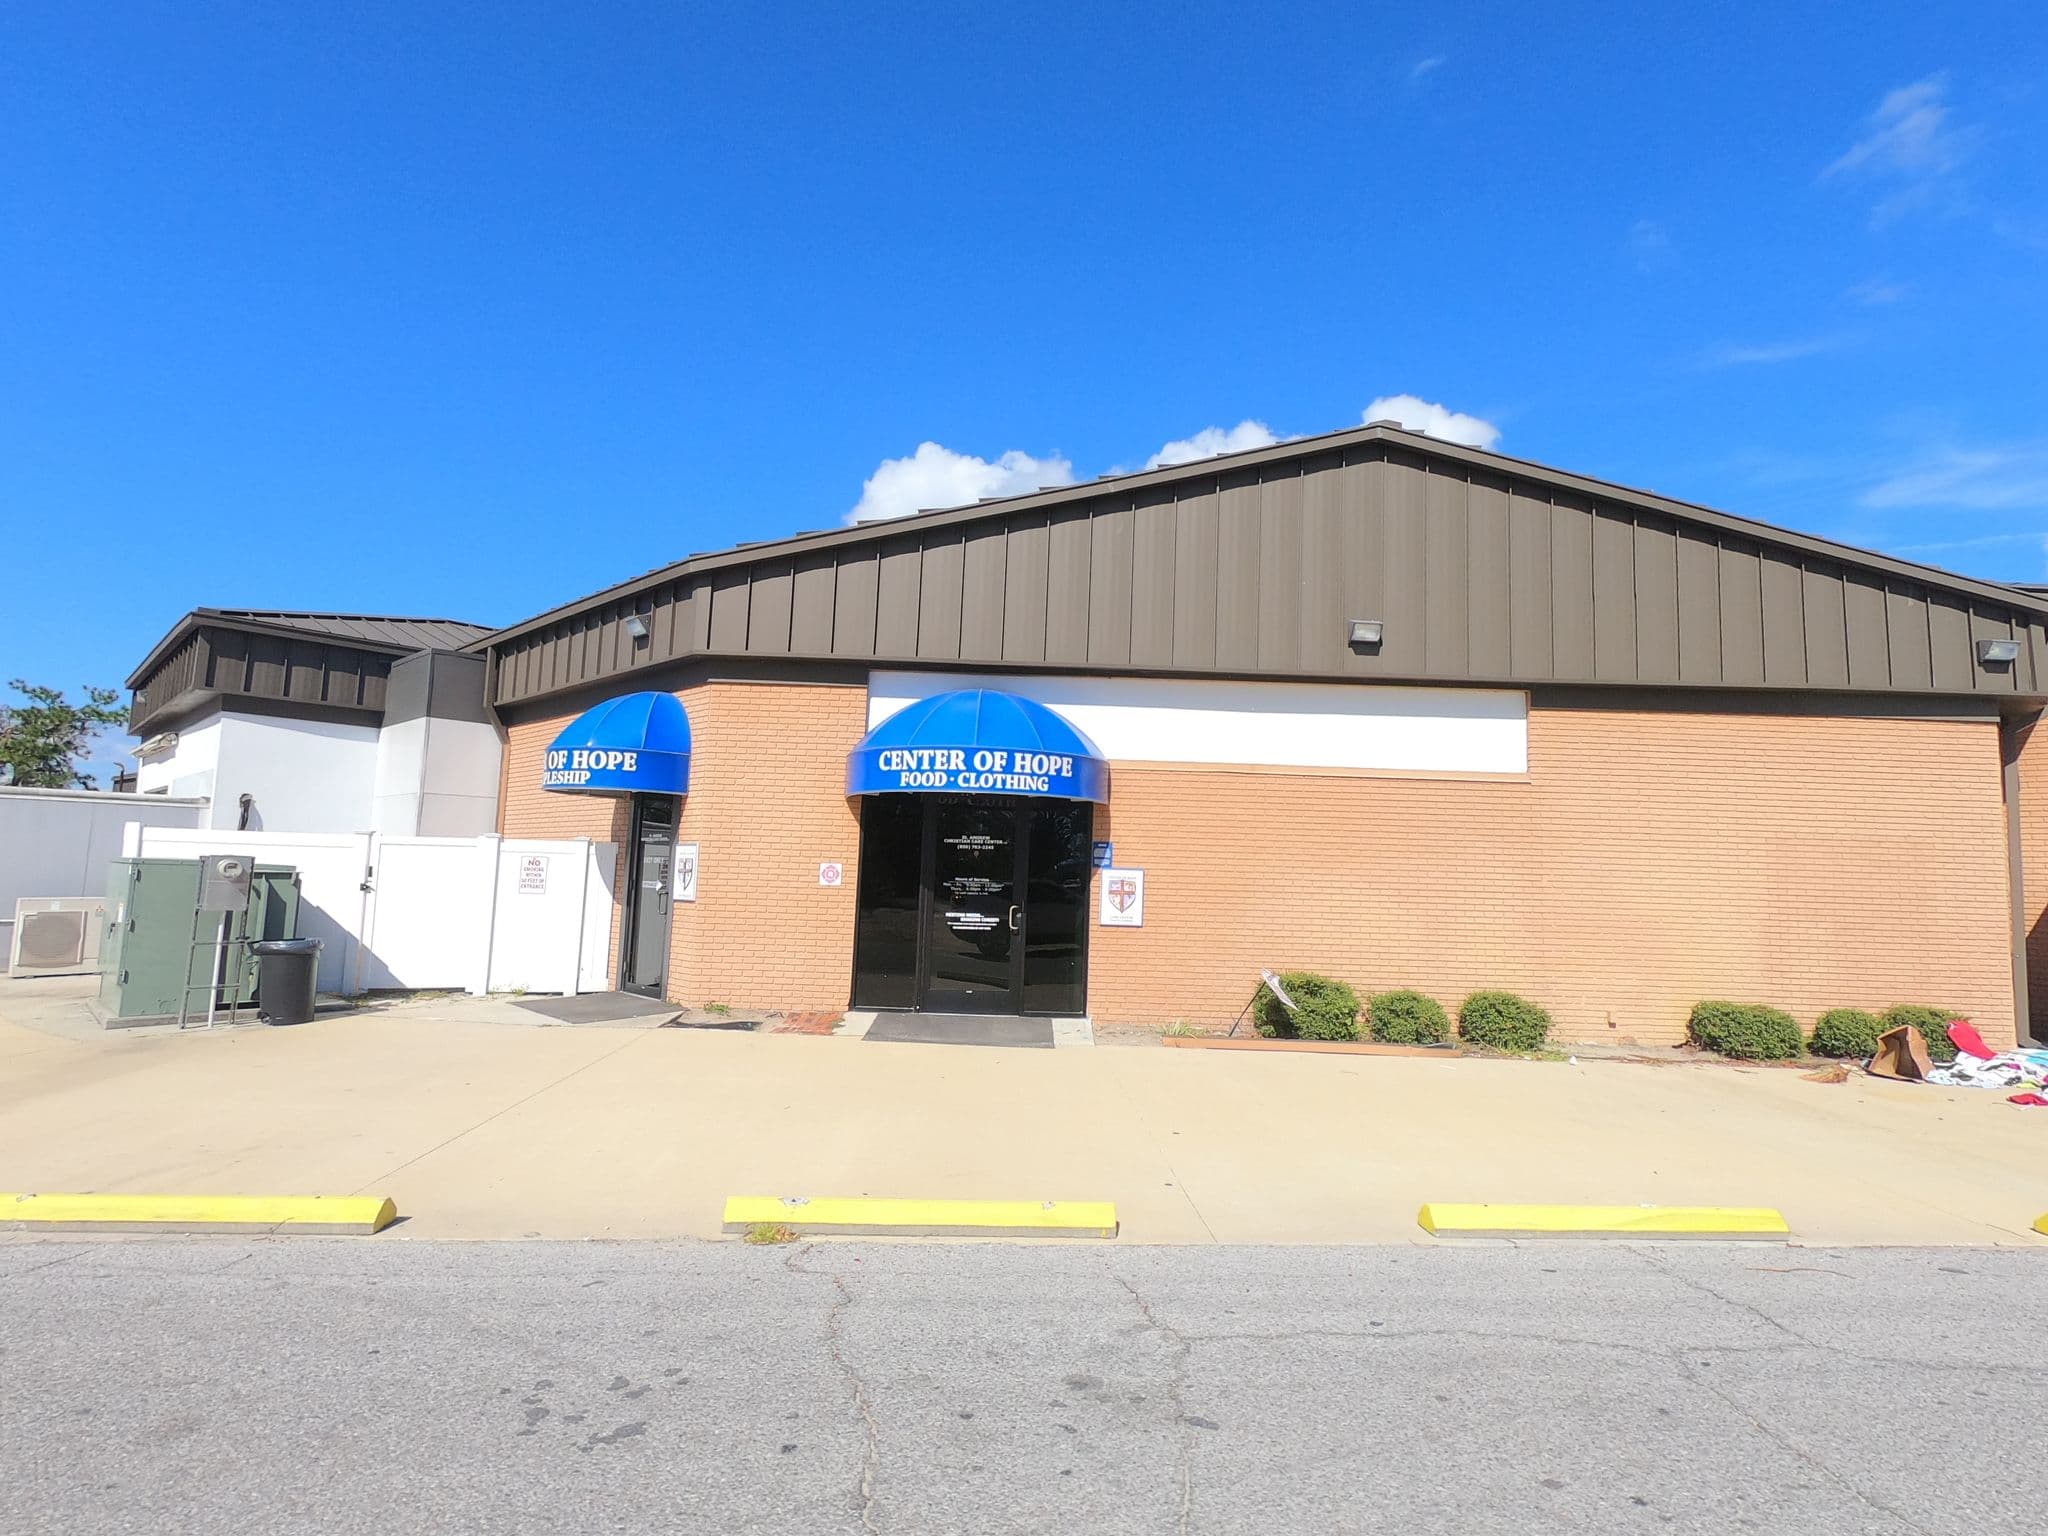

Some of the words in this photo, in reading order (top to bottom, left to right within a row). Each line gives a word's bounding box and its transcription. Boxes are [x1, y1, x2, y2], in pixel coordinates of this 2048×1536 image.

[548, 750, 568, 769] OF
[571, 750, 638, 771] HOPE
[878, 749, 967, 771] CENTER
[973, 750, 1008, 772] OF
[1013, 752, 1073, 777] HOPE
[899, 771, 947, 787] FOOD
[957, 772, 1049, 792] CLOTHING
